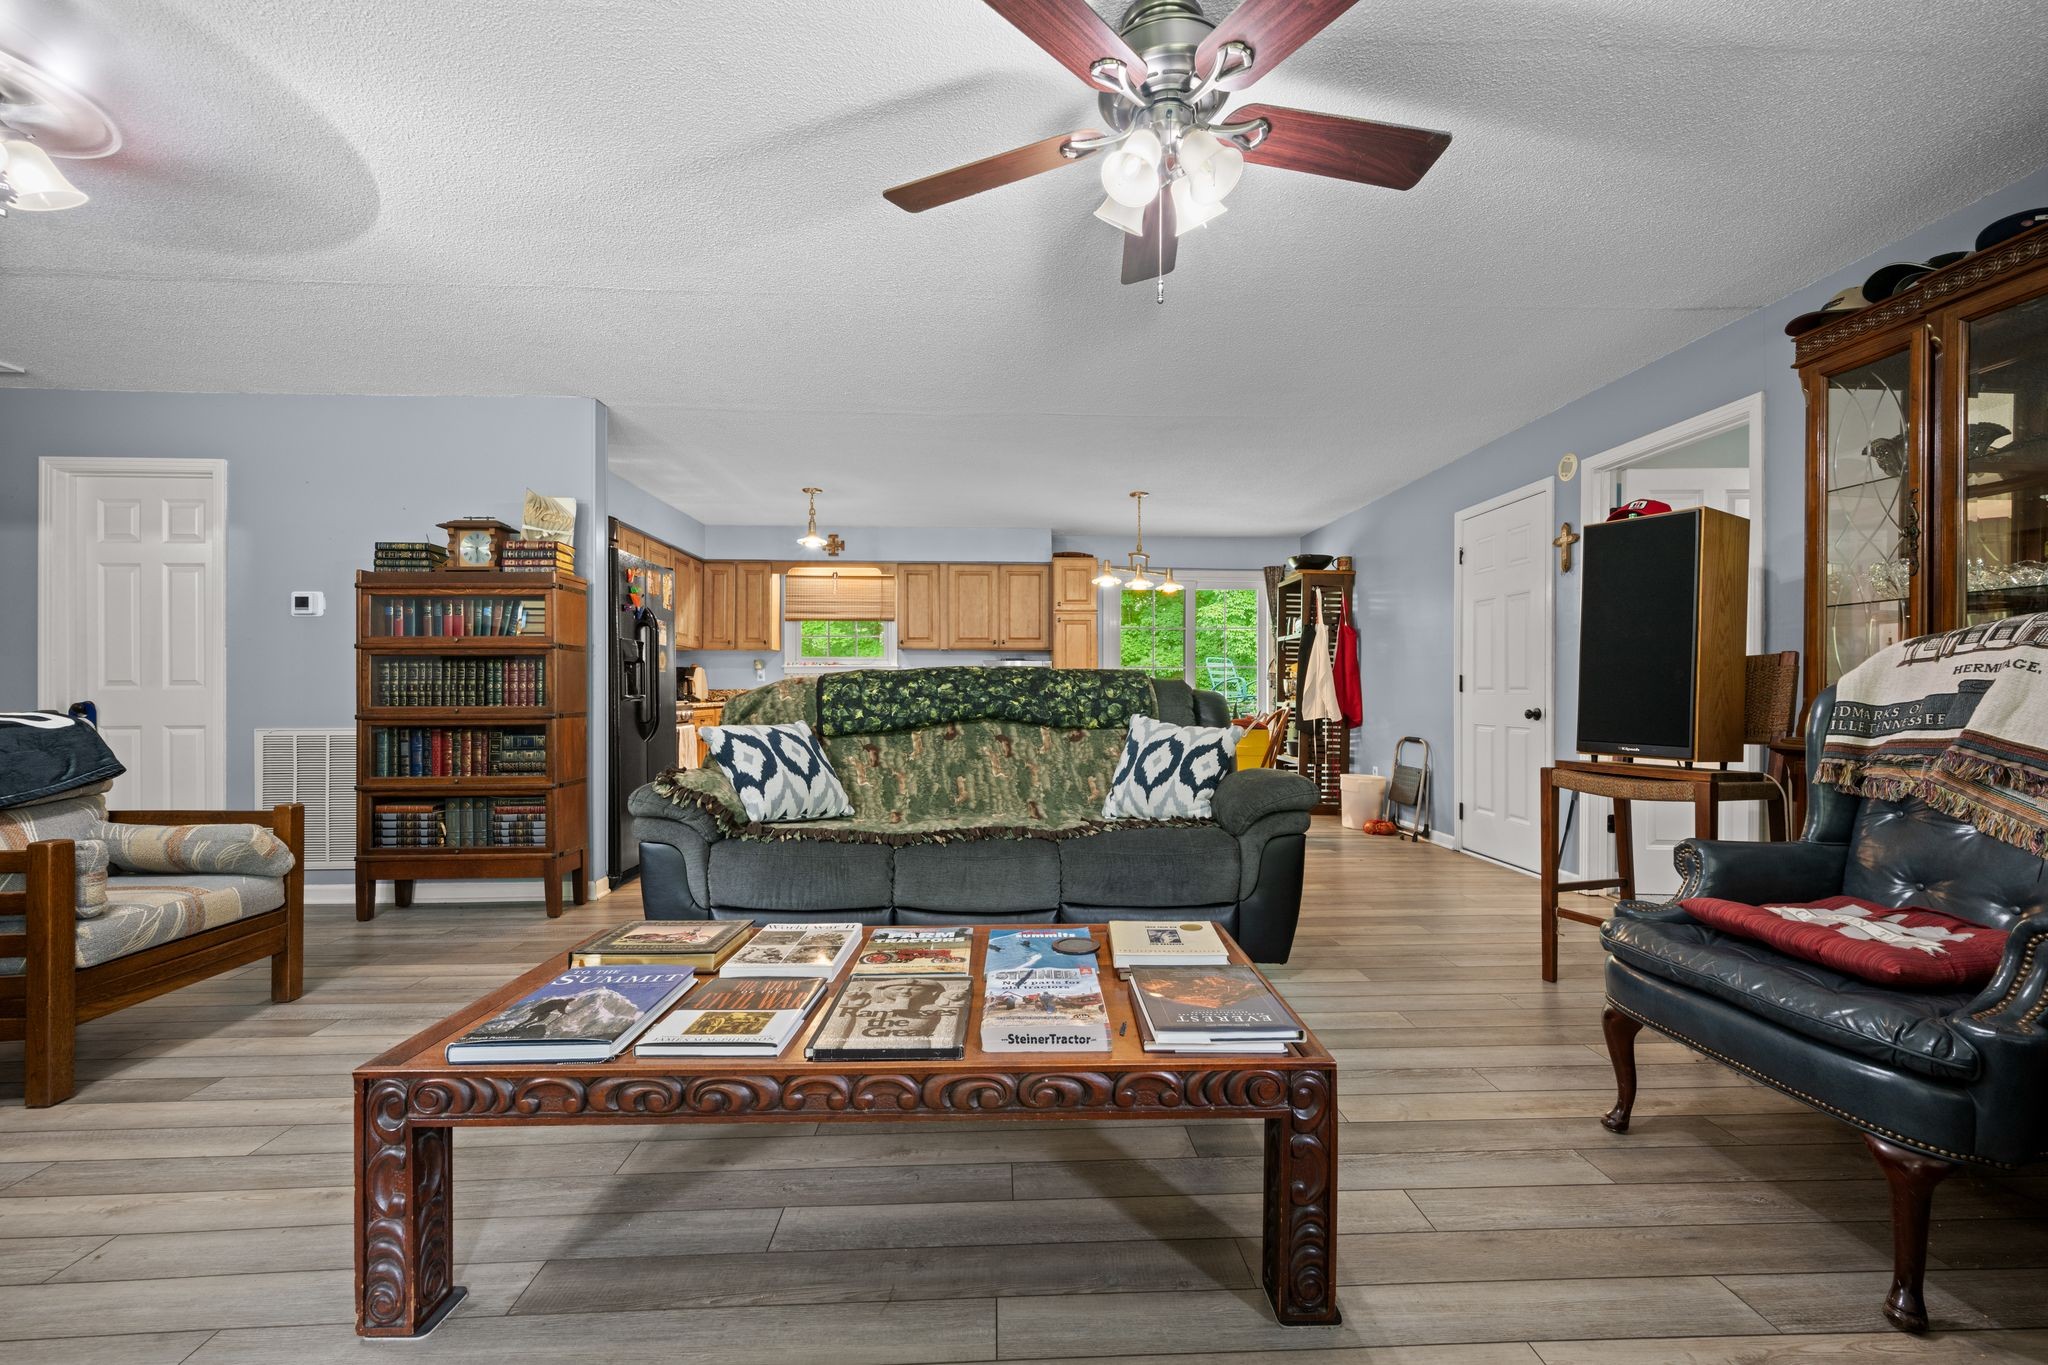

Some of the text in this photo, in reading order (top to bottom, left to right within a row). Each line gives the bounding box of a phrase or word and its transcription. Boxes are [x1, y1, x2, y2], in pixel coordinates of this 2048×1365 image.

[1952, 658, 2042, 676] HERMIAGE.
[1869, 713, 1946, 734] TENNESSEE
[552, 974, 684, 985] SUMMIT
[694, 992, 808, 1009] CIVIL WAR
[839, 1008, 958, 1018] Ramses
[1177, 1014, 1272, 1022] EVEREST
[867, 1017, 910, 1027] the
[1007, 1033, 1091, 1045] SteinerTractor
